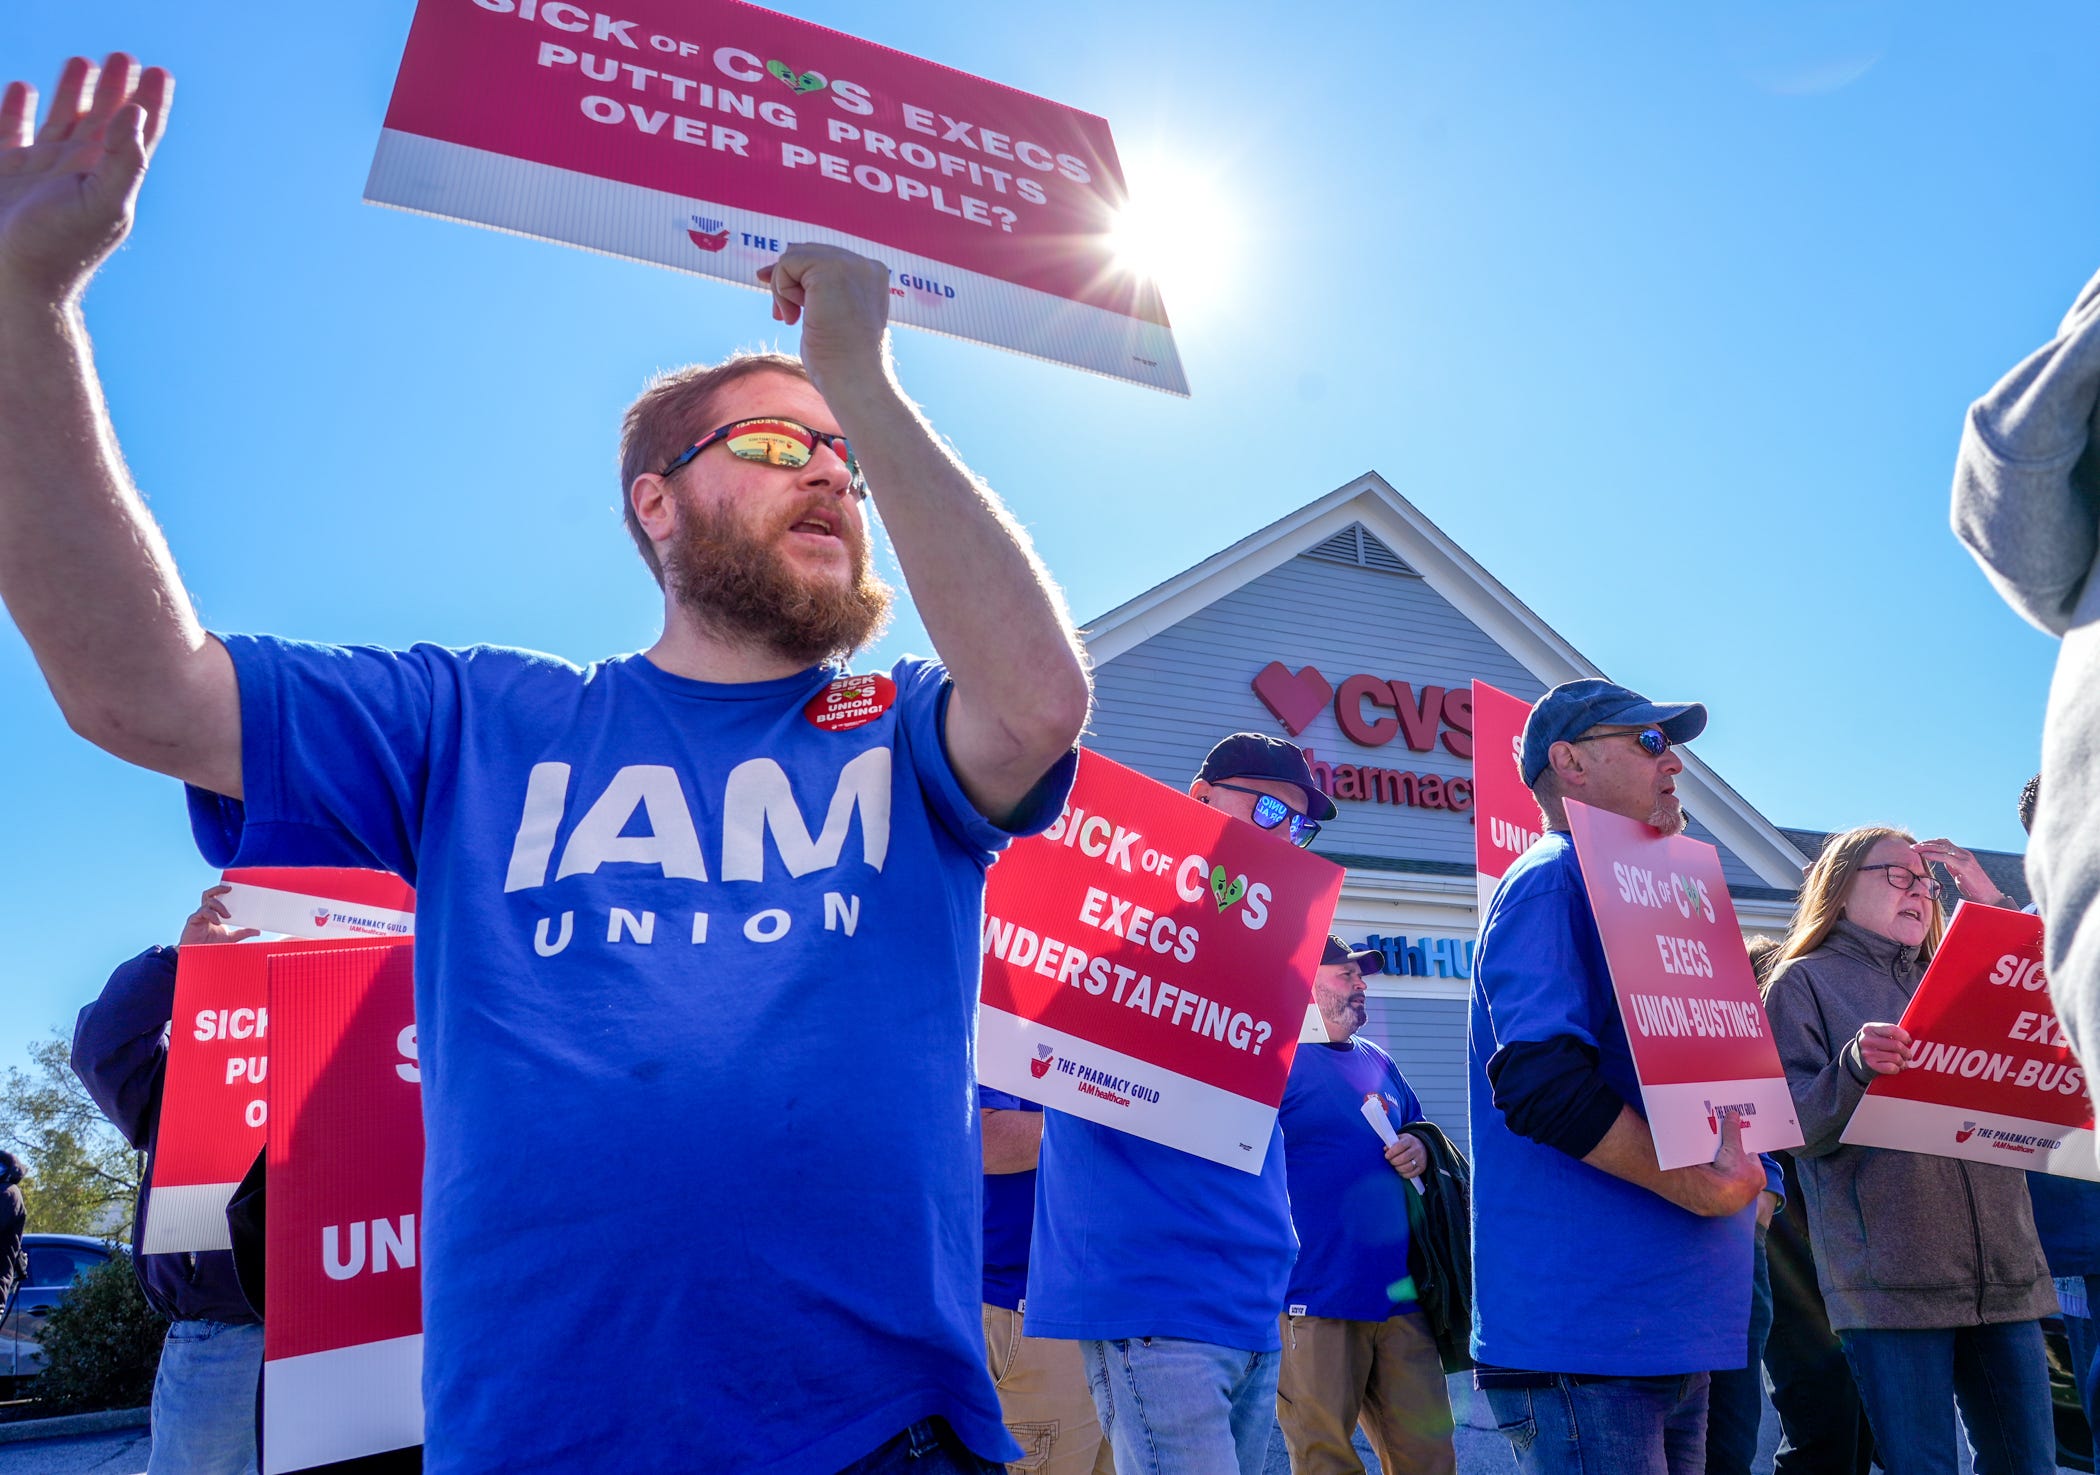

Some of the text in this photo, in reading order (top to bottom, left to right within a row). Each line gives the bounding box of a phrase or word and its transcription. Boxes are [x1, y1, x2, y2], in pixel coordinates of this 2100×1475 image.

[537, 41, 1047, 205] PUTTING PROFITS
[650, 34, 699, 57] OF
[902, 103, 1091, 184] EXECS
[580, 95, 1017, 232] OVER PEOPLE?
[741, 232, 779, 252] THE
[900, 273, 955, 299] GUILD
[828, 698, 872, 711] UNION
[830, 676, 875, 690] SICK
[817, 705, 882, 722] BUSTING!
[1303, 748, 1474, 819] harmac
[504, 746, 891, 893] IAM
[1141, 849, 1173, 877] OF
[1613, 860, 1662, 909] SICK
[1657, 882, 1671, 903] OF
[333, 914, 407, 933] THE PHARMACY GUILD
[534, 892, 860, 957] UNION
[1078, 887, 1199, 963] EXECS
[1655, 934, 1713, 979] EXECS
[1990, 954, 2049, 993] SIC
[983, 913, 1272, 1056] NDERSTAFFING?
[1630, 994, 1763, 1038] UNION-BUSTING?
[1057, 1058, 1160, 1104] THE PHARMACY GUILD
[1907, 1039, 2089, 1098] UNION-BUS
[1977, 1128, 2061, 1150] THE PHARMACY GUILD
